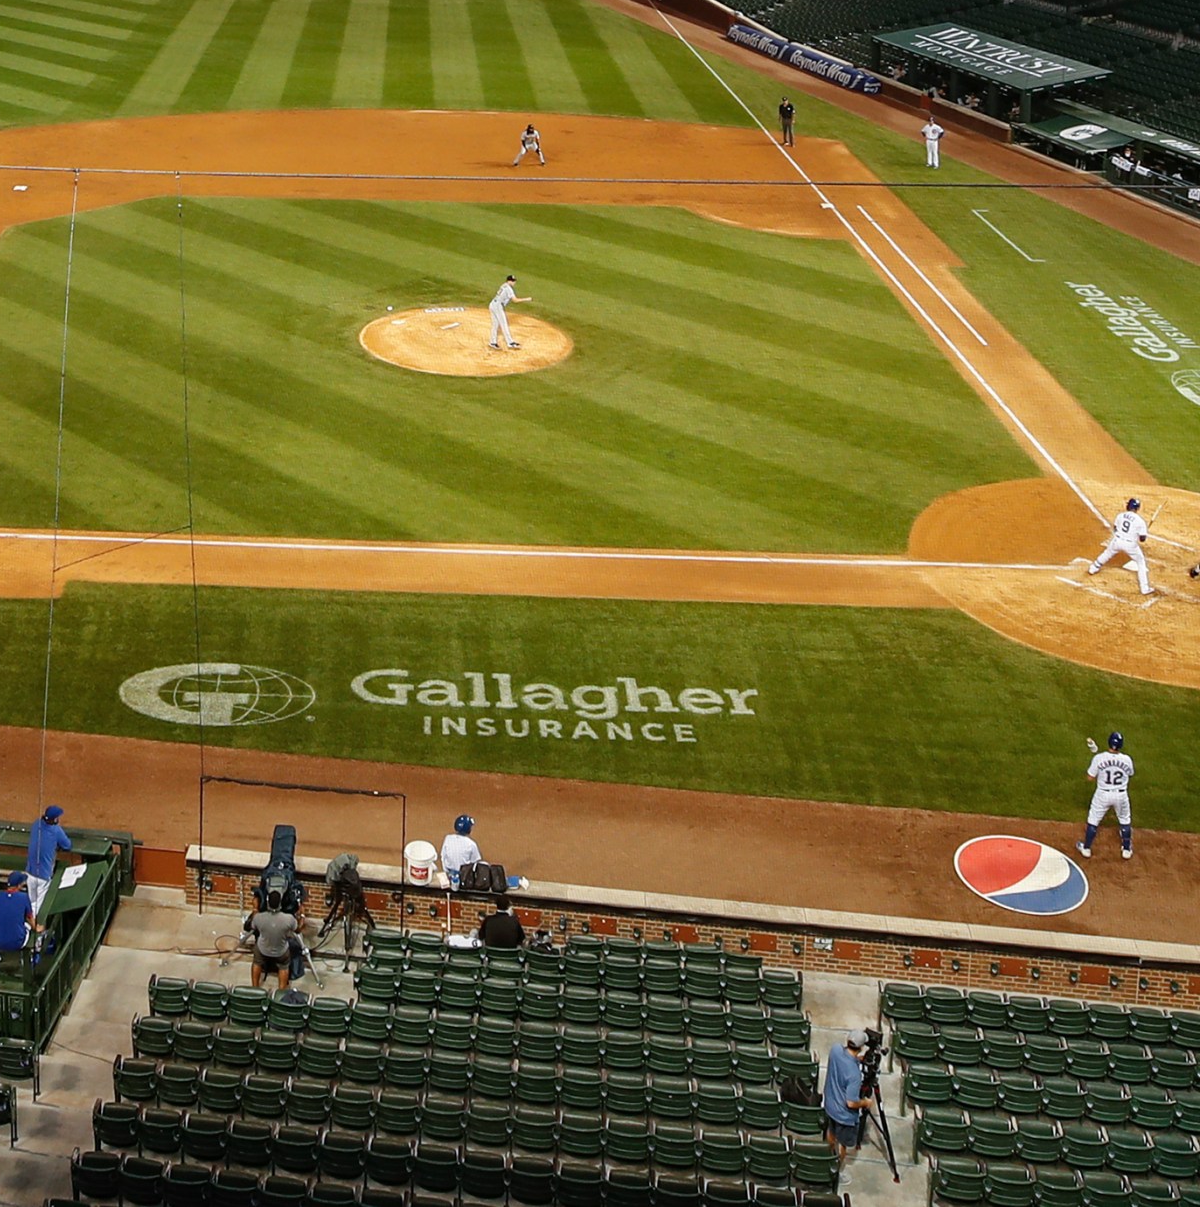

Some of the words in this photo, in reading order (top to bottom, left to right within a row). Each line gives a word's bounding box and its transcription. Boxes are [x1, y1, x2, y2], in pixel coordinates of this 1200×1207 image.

[758, 36, 778, 56] Wrap
[910, 40, 1013, 76] MORTGAGE
[928, 27, 1075, 74] WINTRUST
[790, 50, 828, 75] Reynolds
[826, 64, 851, 86] Wrap
[1064, 281, 1180, 363] Gallagher
[1120, 296, 1200, 349] INSURANCE
[1122, 520, 1130, 533] 9
[350, 668, 759, 720] Gallagher
[423, 716, 698, 743] INSURANCE
[1104, 770, 1124, 785] 12
